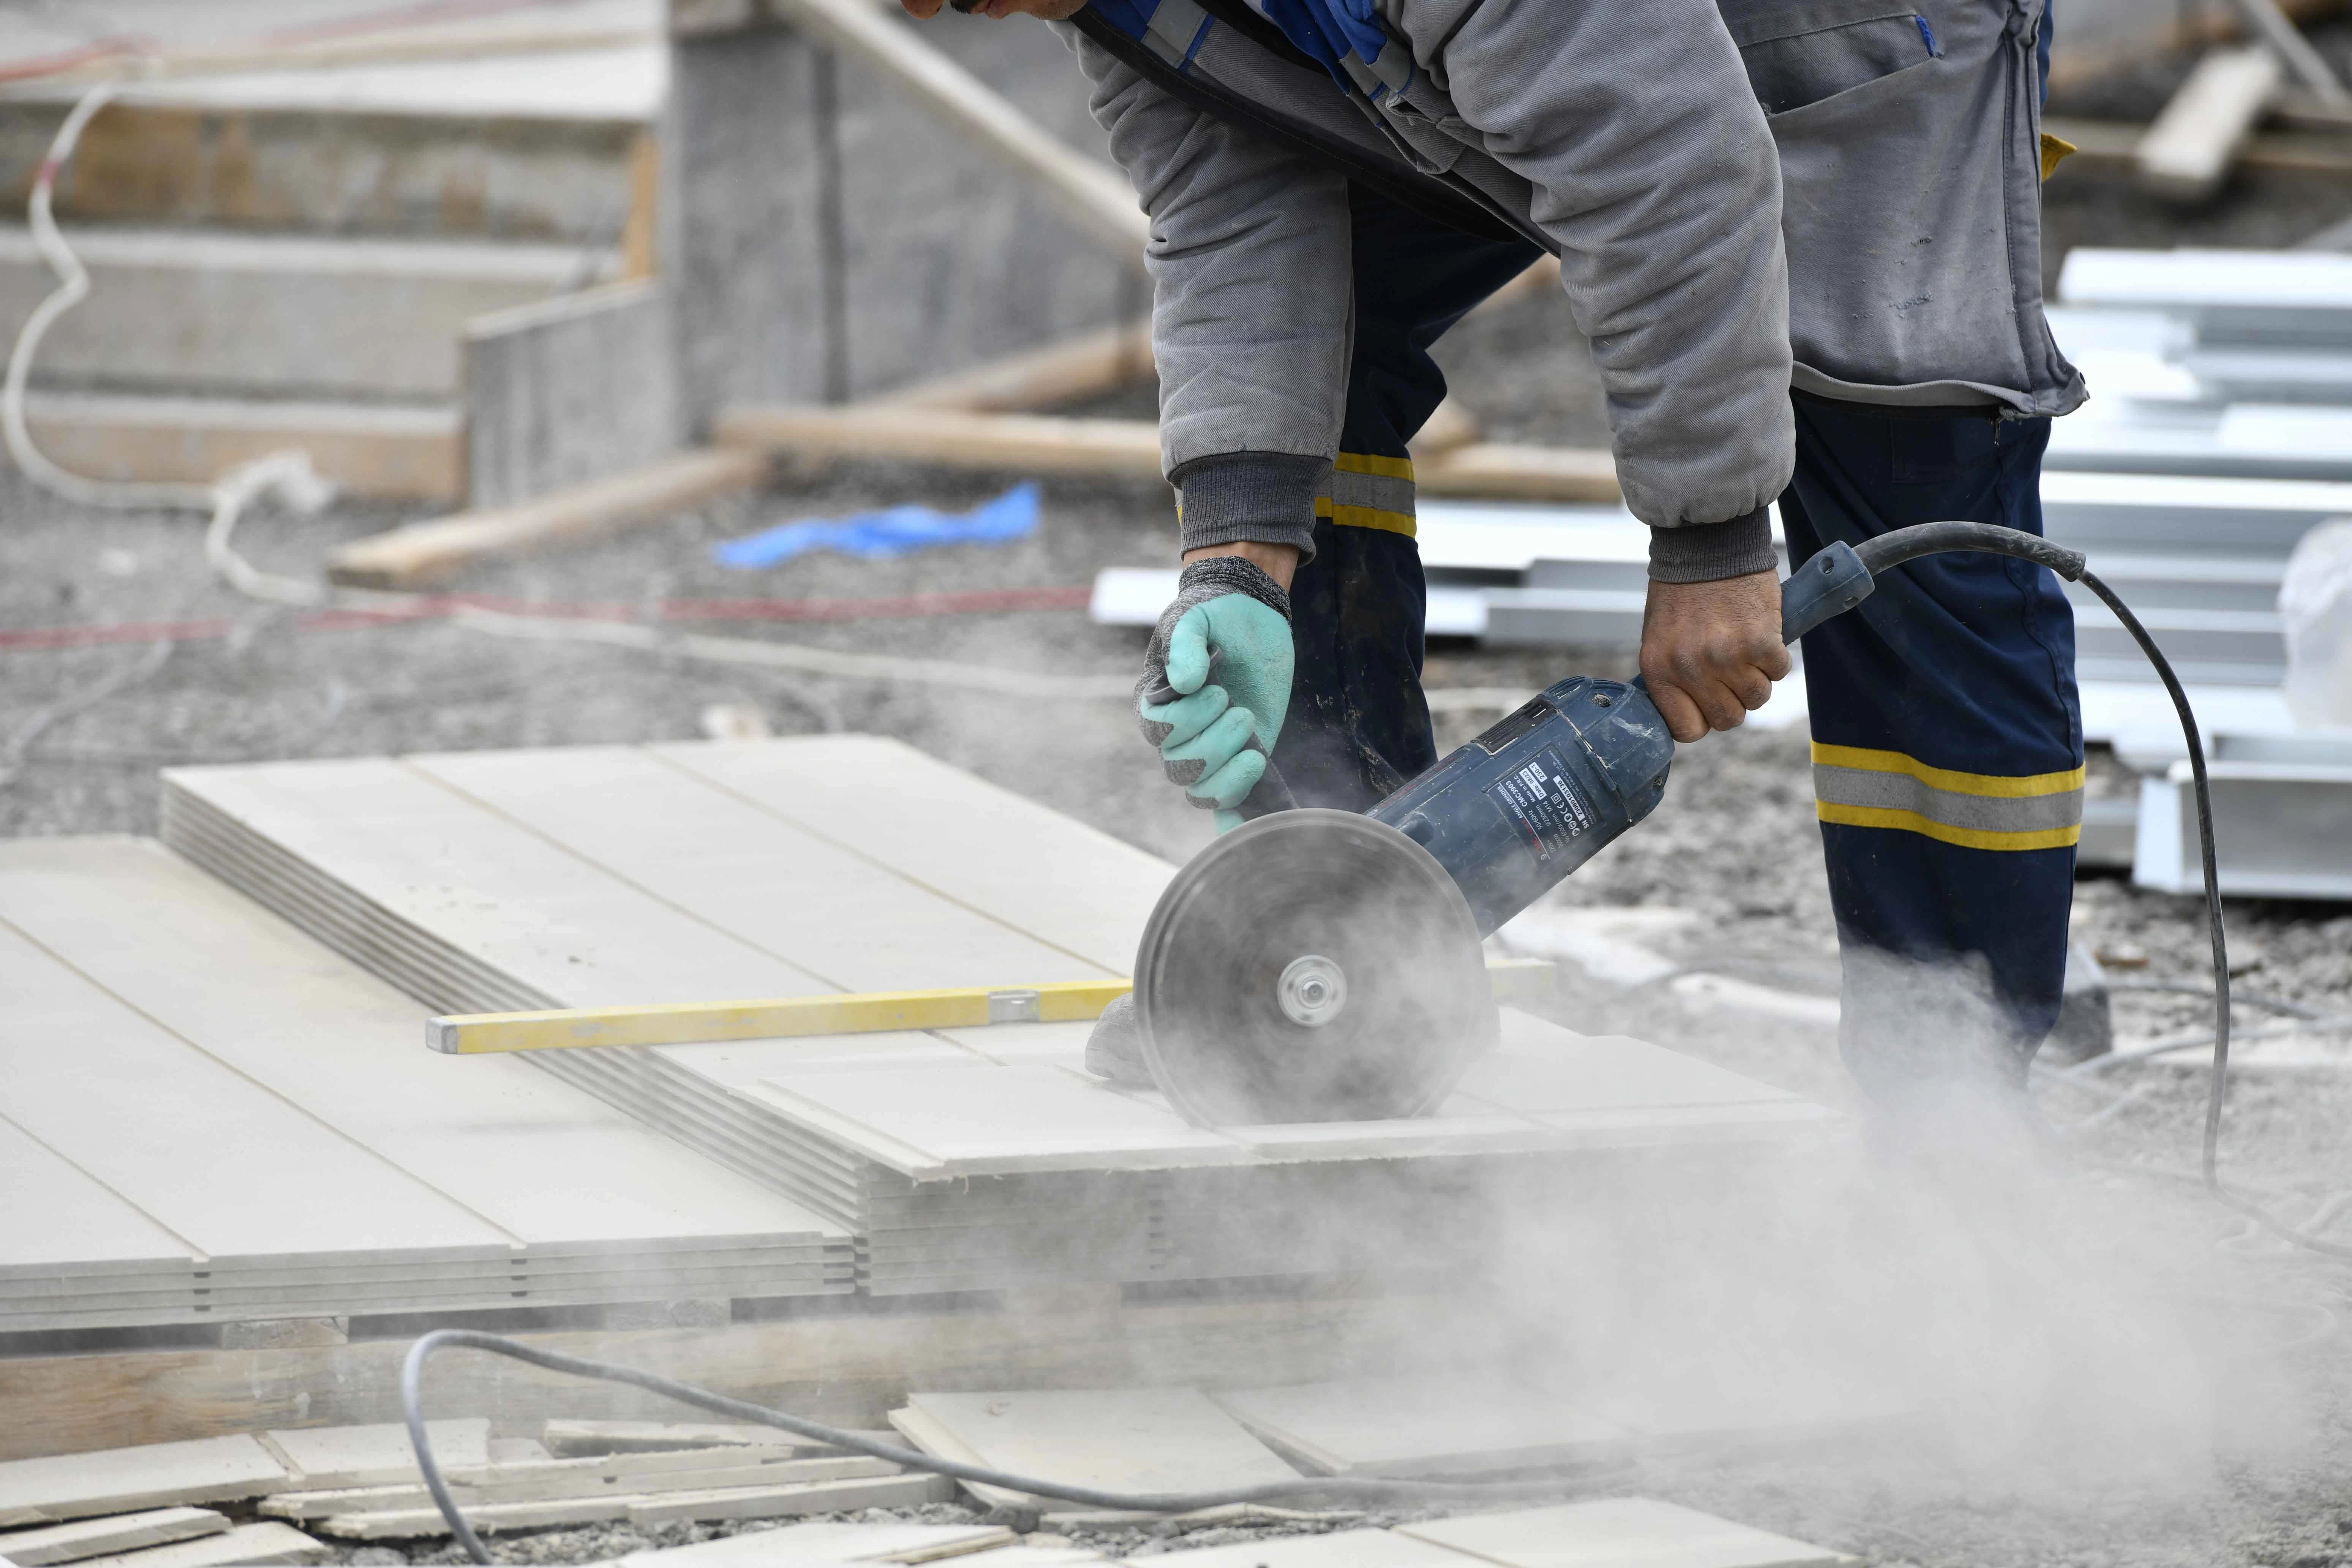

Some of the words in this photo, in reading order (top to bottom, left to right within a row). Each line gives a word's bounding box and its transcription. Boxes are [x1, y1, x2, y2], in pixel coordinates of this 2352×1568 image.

[1522, 770, 1534, 784] 08/23
[1531, 763, 1545, 779] 230-1
[1512, 773, 1524, 787] P.R.C.
[1497, 785, 1513, 805] GRINDER
[1505, 779, 1528, 808] CMC3903
[1525, 790, 1536, 802] Made
[1532, 783, 1544, 797] Date:
[1557, 780, 1582, 816] 23080103136
[1510, 803, 1523, 819] ANGLE
[1542, 800, 1553, 812] M14
[1527, 809, 1543, 830] 50/60Hz
[1581, 819, 1590, 829] SN
